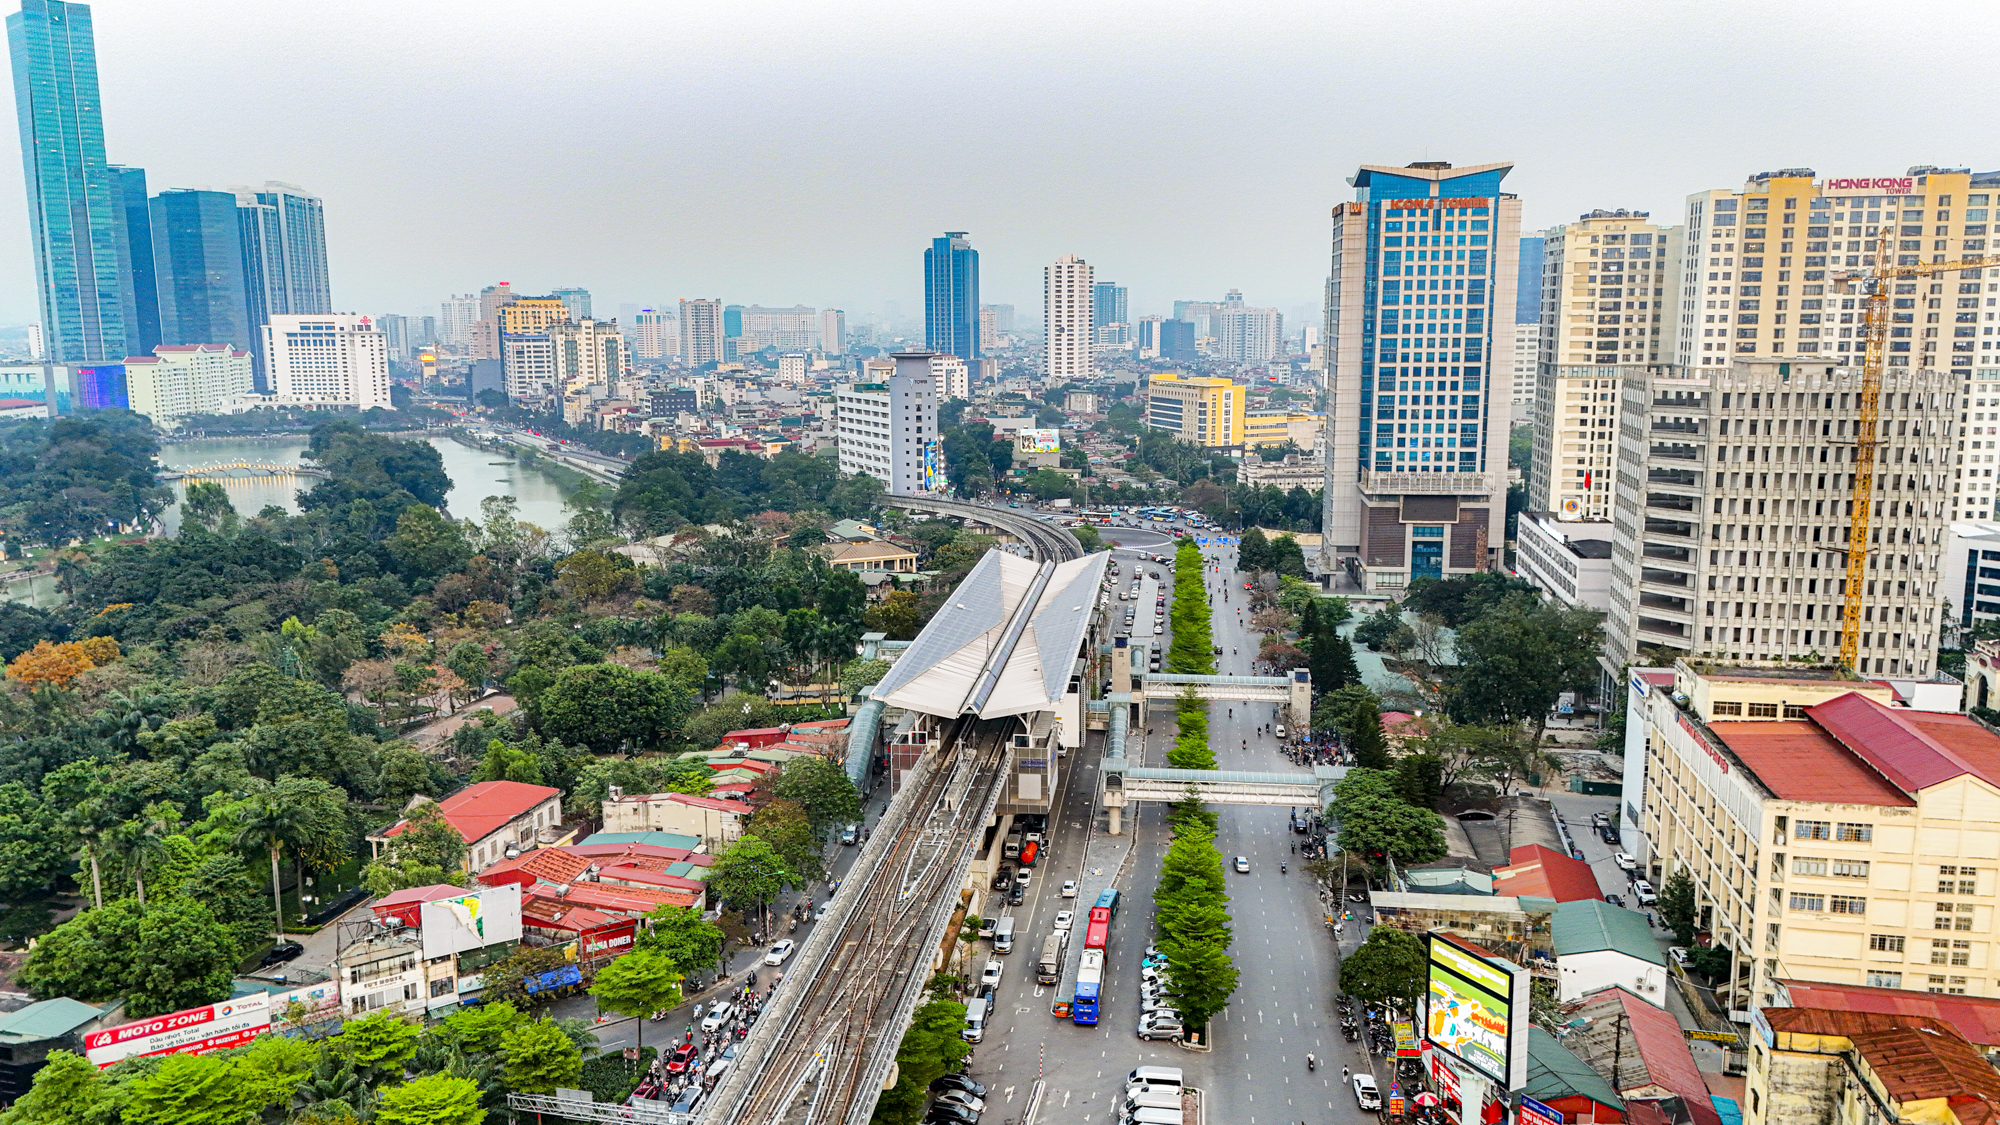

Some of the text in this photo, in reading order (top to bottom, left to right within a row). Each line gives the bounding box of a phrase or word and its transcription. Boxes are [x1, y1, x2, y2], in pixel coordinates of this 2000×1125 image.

[1828, 178, 1913, 189] HONG KONG
[1442, 197, 1489, 209] TOWER
[0, 372, 37, 385] TTE
[608, 934, 631, 948] DONER
[236, 1001, 263, 1010] TOTAL
[118, 1011, 208, 1040] MOTO ZONE
[183, 1027, 200, 1036] Total
[215, 1034, 240, 1045] SUZUKI
